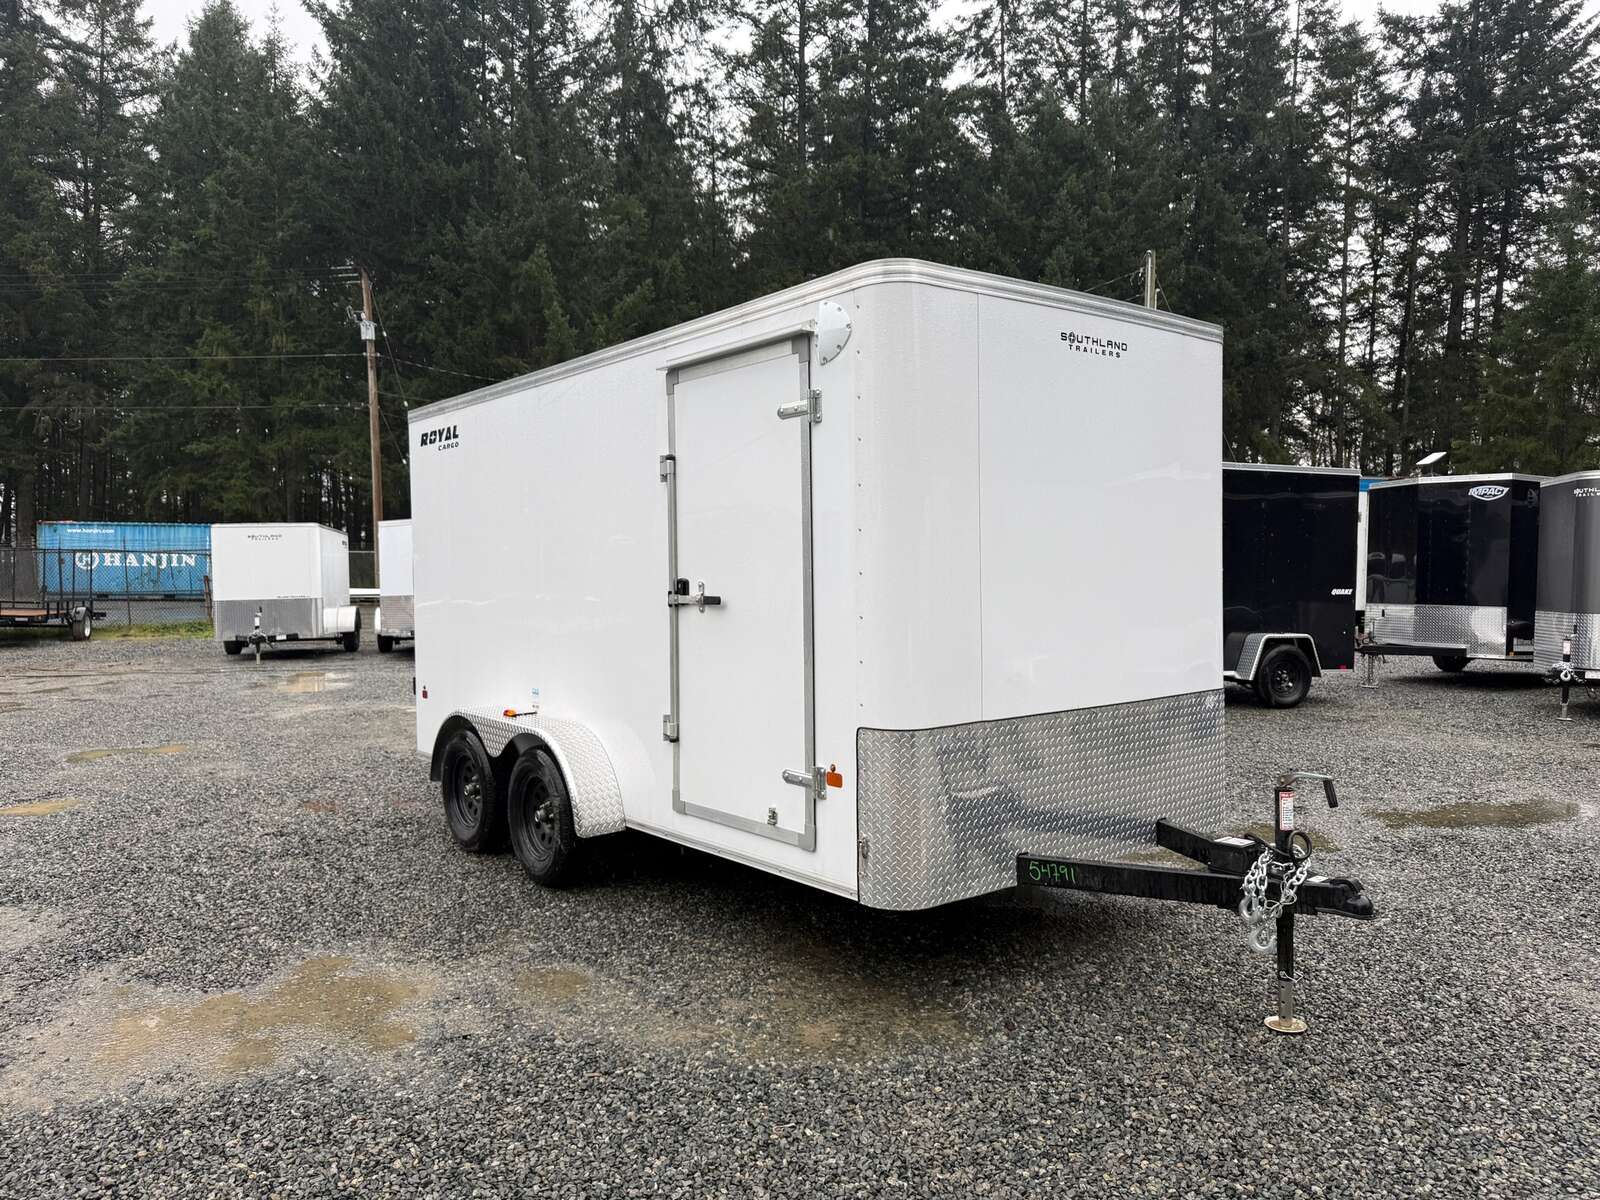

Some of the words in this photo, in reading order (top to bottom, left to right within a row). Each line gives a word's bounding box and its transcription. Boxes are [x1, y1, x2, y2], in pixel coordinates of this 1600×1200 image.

[1060, 331, 1128, 352] SOUTHLAND
[1068, 343, 1121, 358] TRAILERS
[420, 424, 459, 447] ROYAL
[438, 441, 459, 451] CARGO
[103, 552, 198, 569] HANJIN
[1029, 860, 1077, 884] 54791
